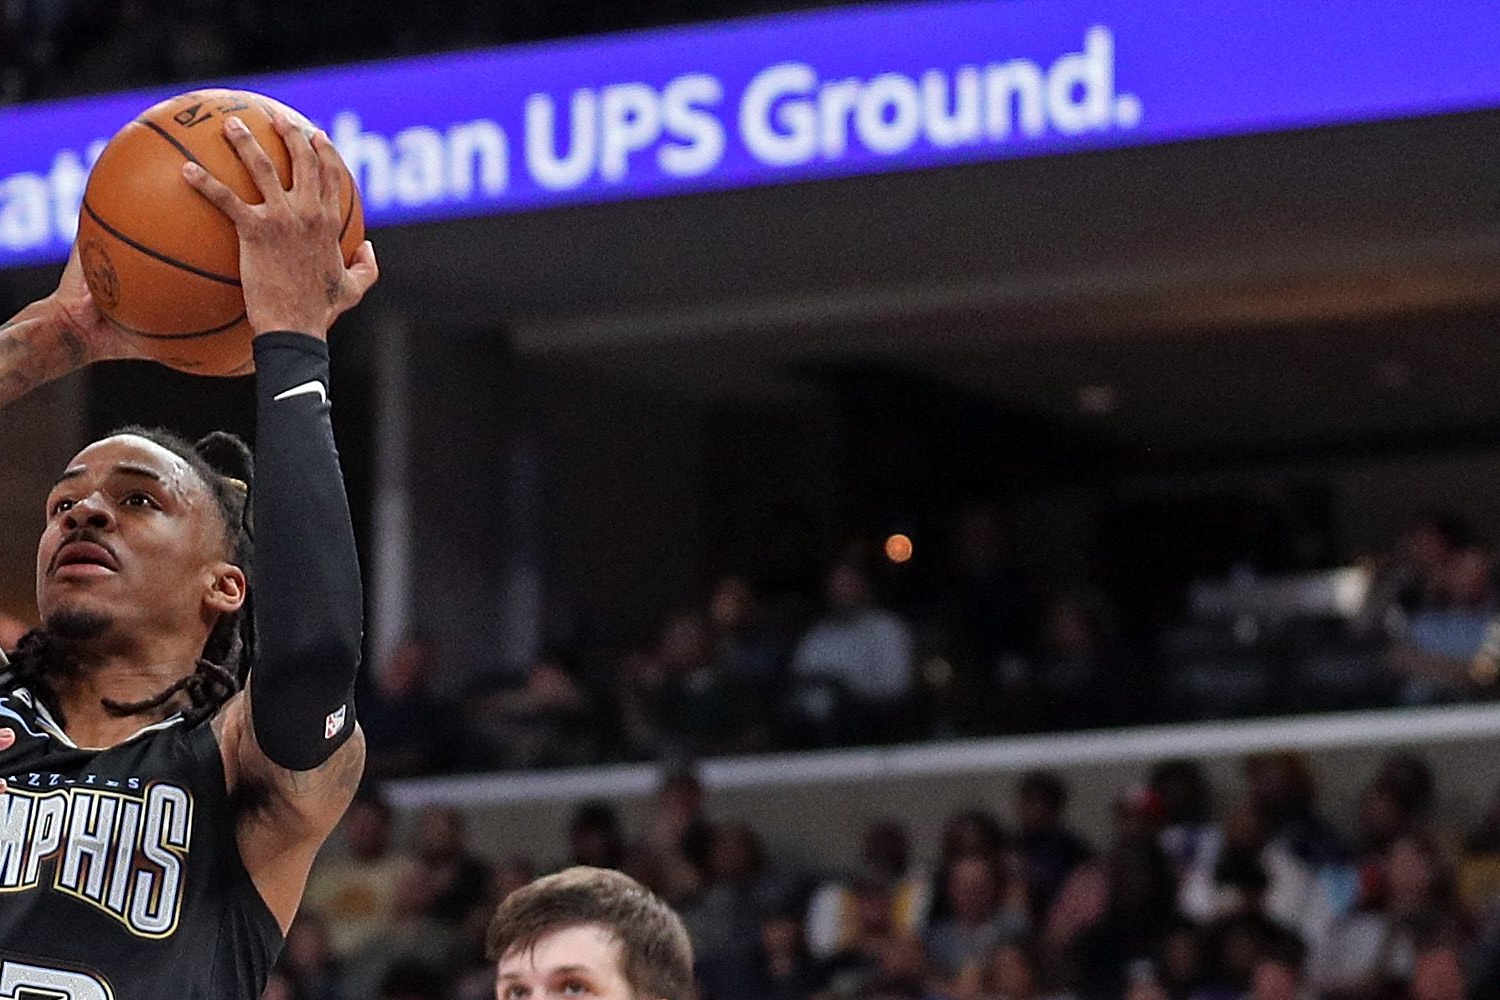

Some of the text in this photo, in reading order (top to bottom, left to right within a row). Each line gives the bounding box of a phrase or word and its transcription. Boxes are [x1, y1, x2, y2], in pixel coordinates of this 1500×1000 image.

[336, 112, 508, 210] han
[525, 74, 725, 190] UPS
[739, 26, 1142, 166] Ground.
